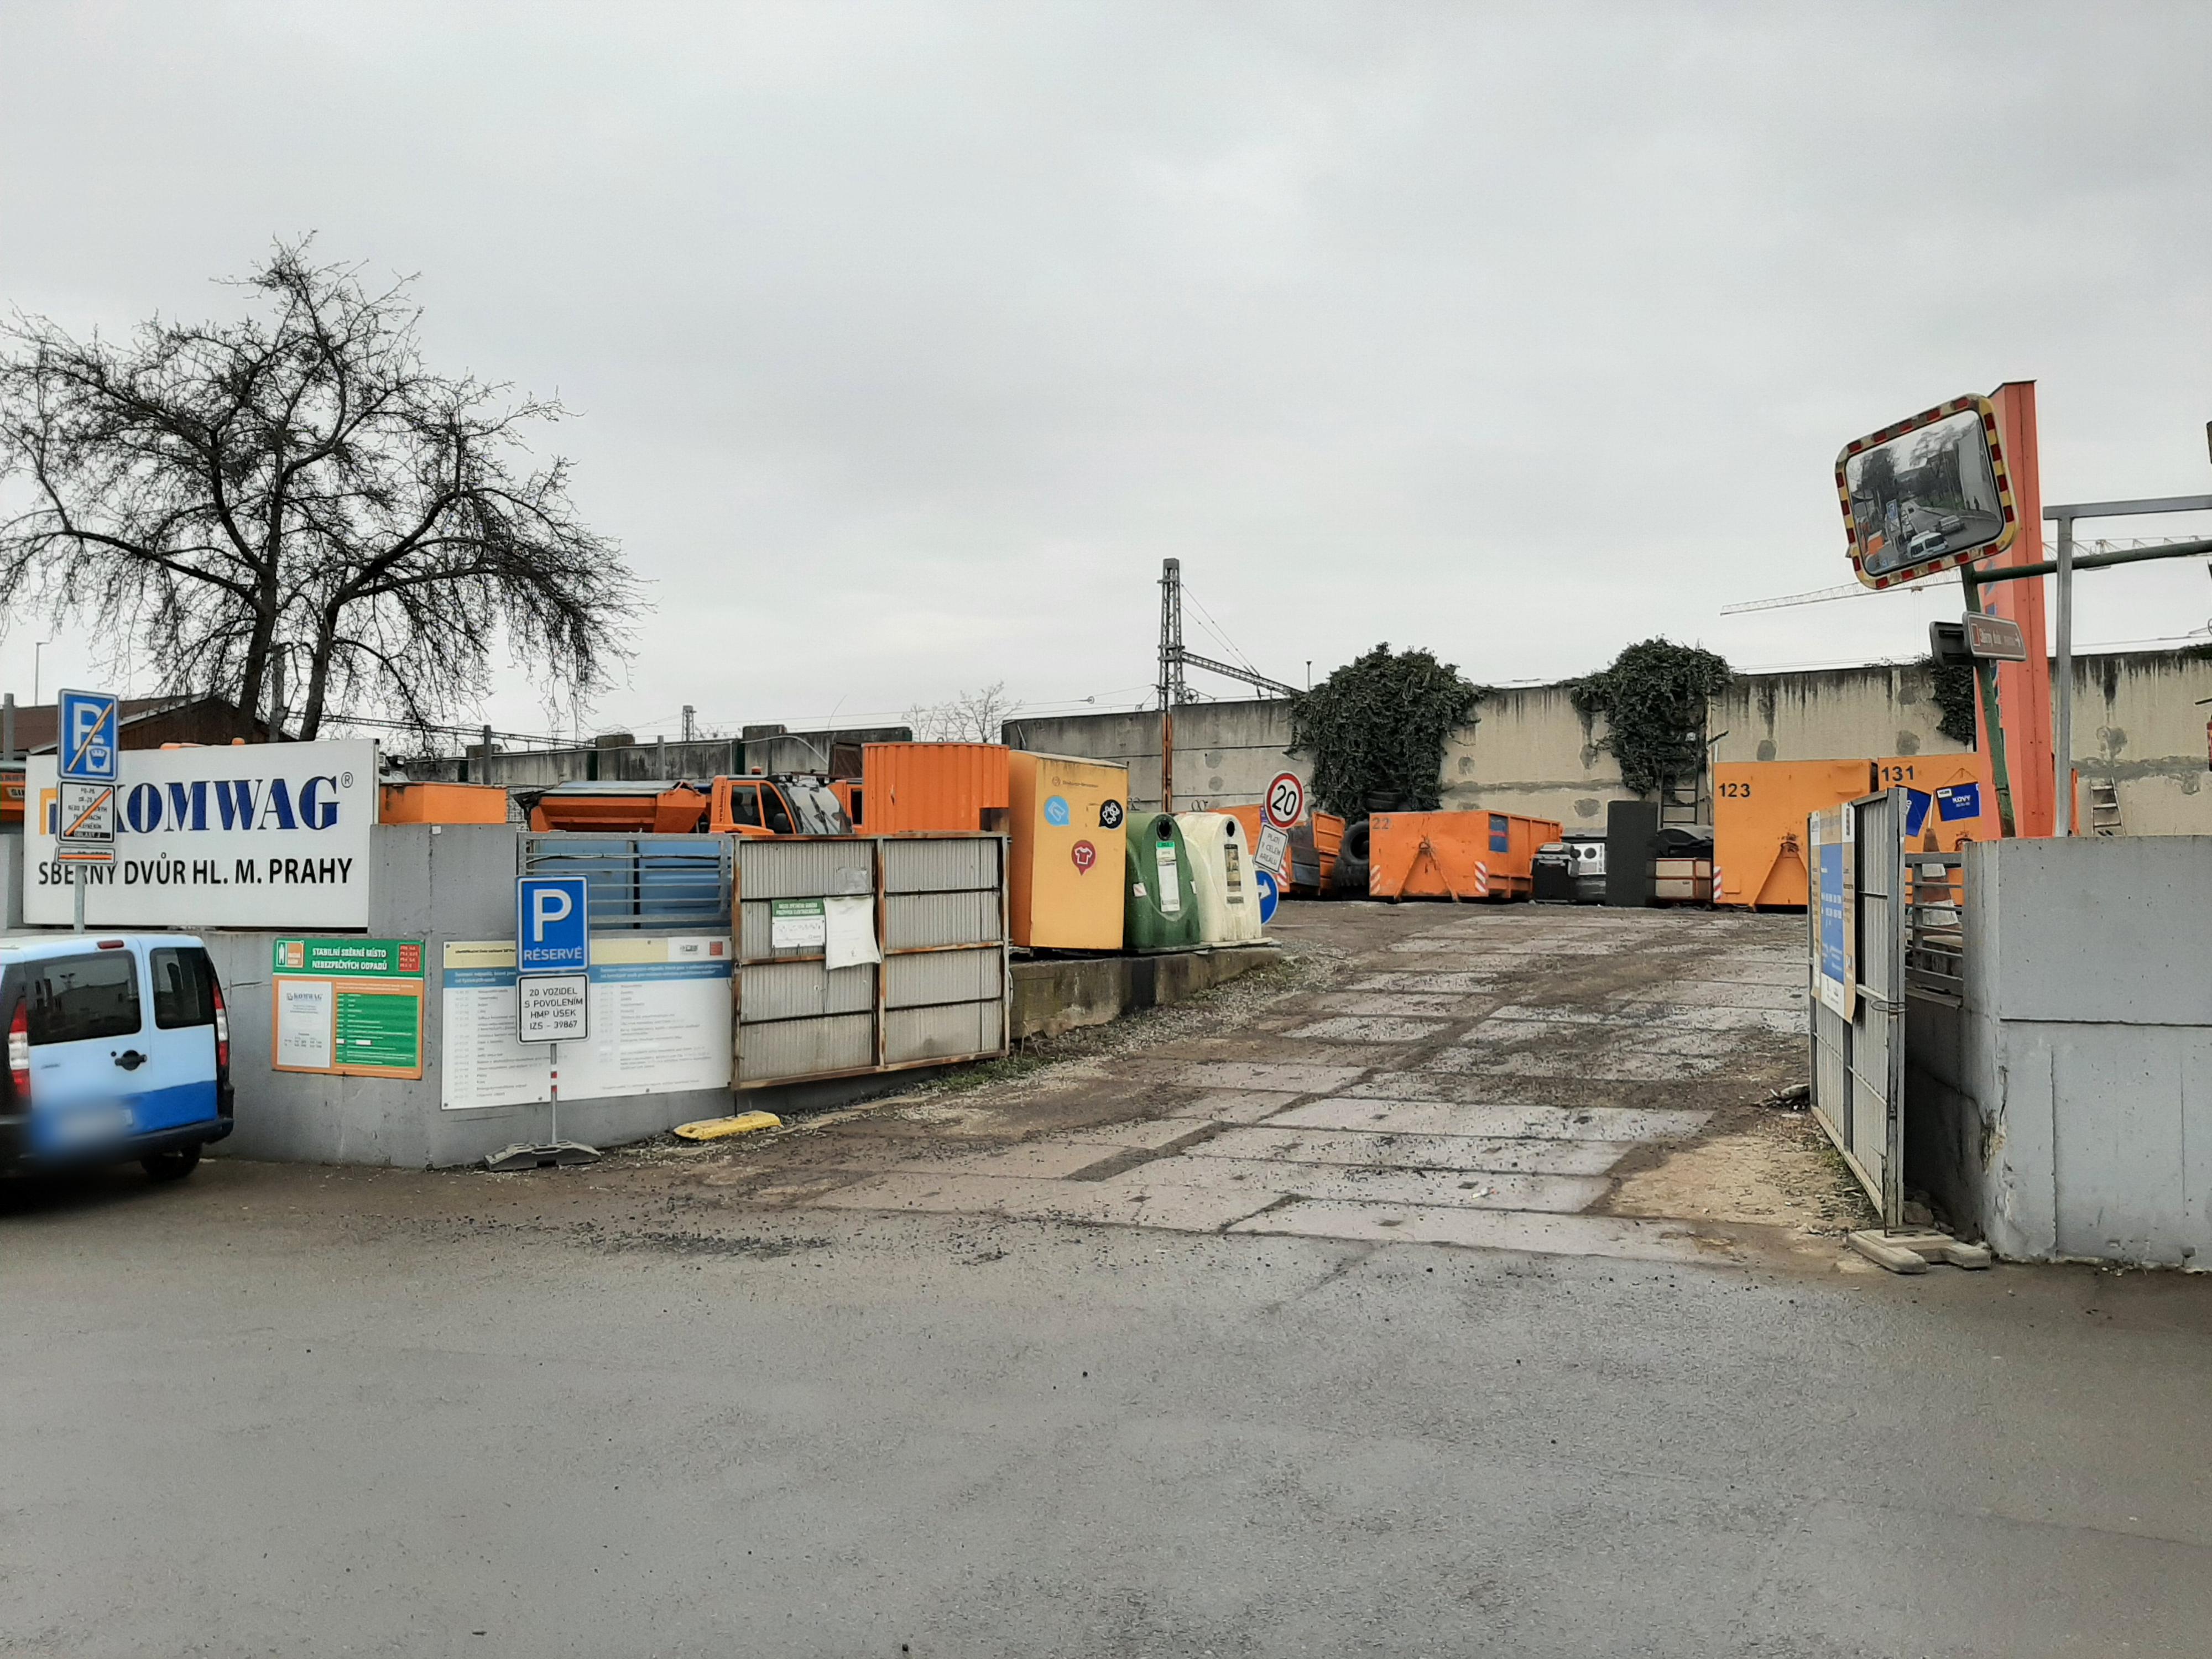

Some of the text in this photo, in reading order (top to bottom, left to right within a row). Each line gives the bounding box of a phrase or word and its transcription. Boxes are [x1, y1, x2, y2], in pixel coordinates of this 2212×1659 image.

[1881, 765, 1914, 781] 131
[1719, 782, 1751, 798] 123
[1272, 784, 1297, 816] 20
[1371, 817, 1390, 830] 22
[124, 852, 186, 884] DVŮR
[193, 859, 228, 884] HL.
[235, 859, 263, 884] M.
[269, 858, 353, 884] PRAHY
[534, 889, 572, 942] P
[524, 947, 583, 961] RÉSERVÉ
[542, 987, 577, 995] VOZIDEL
[534, 998, 583, 1007] POVOLENÍM
[530, 1010, 550, 1019] HMP
[529, 1021, 543, 1030] IZS
[554, 1020, 578, 1029] 39867
